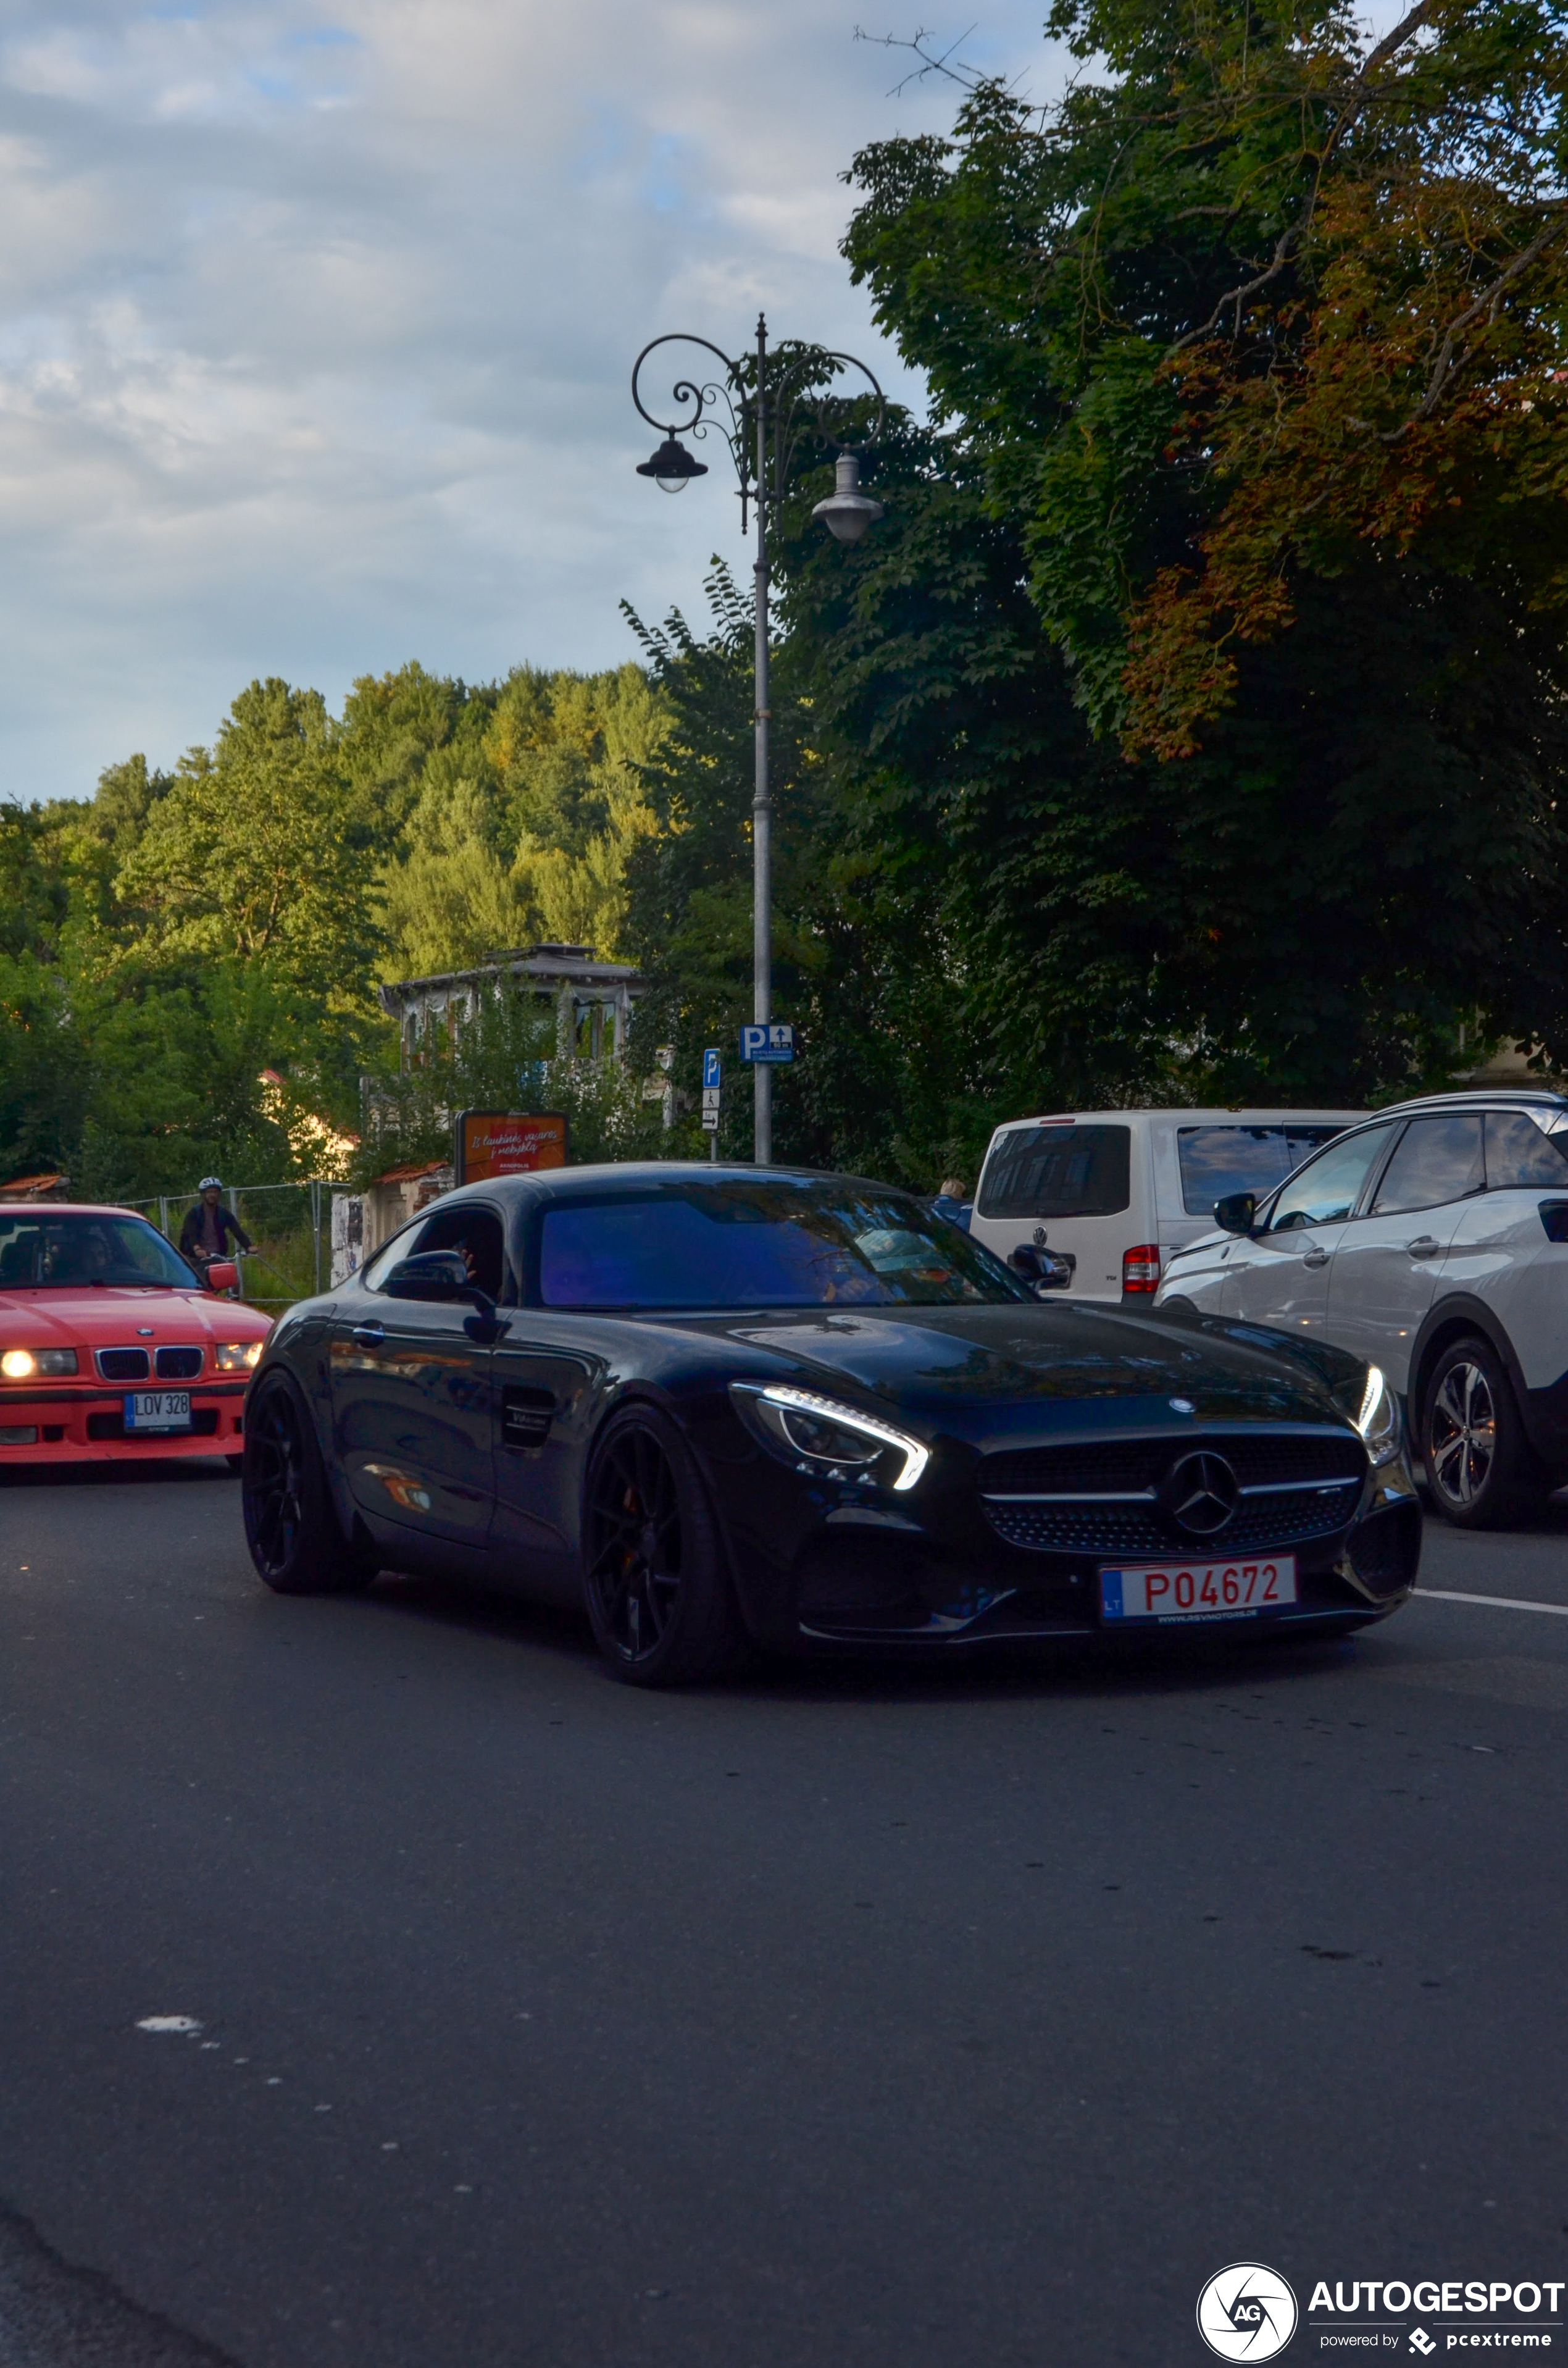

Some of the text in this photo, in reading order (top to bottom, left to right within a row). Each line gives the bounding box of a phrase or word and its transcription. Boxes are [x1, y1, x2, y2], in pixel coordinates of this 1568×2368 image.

[744, 1027, 765, 1060] P
[707, 1054, 717, 1084] P
[524, 1130, 557, 1141] vasaros
[498, 1141, 538, 1156] mokyklą
[135, 1394, 188, 1415] LOV 328
[1104, 1599, 1121, 1610] LT
